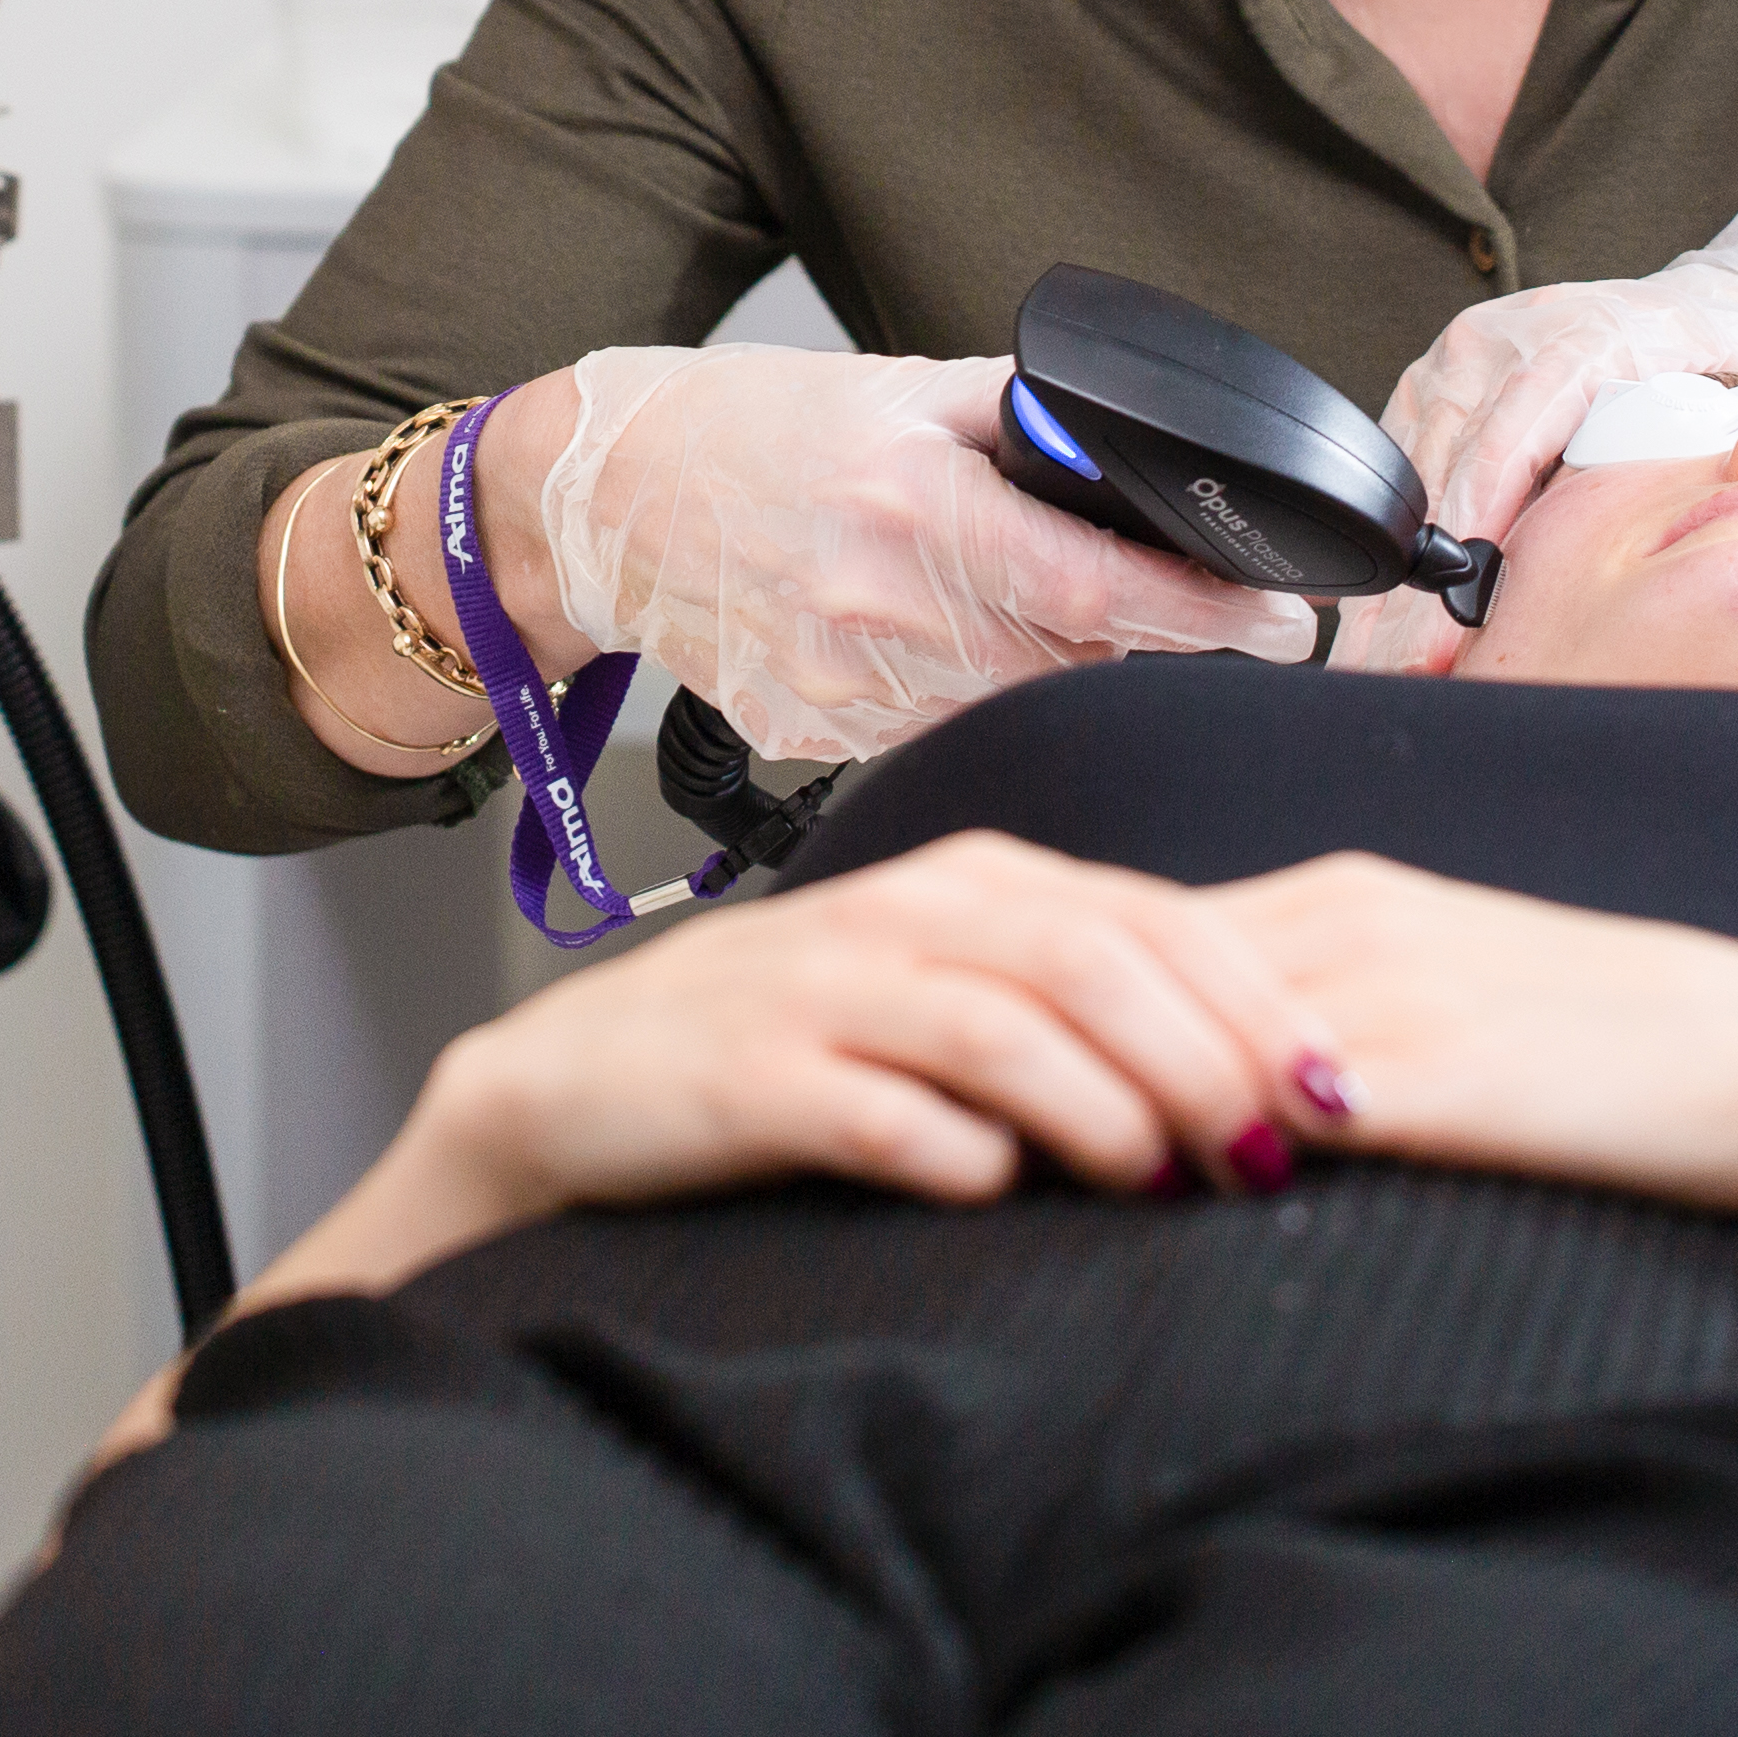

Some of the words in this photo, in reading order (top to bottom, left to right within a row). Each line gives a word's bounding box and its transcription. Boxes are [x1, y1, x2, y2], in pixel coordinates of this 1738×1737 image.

[444, 442, 474, 575] Alma
[1186, 477, 1248, 532] Opus
[1239, 529, 1303, 579] Plasma
[519, 684, 535, 711] Life.
[528, 710, 542, 730] For
[536, 727, 550, 755] You.
[543, 753, 557, 773] For
[546, 776, 606, 899] Alma
